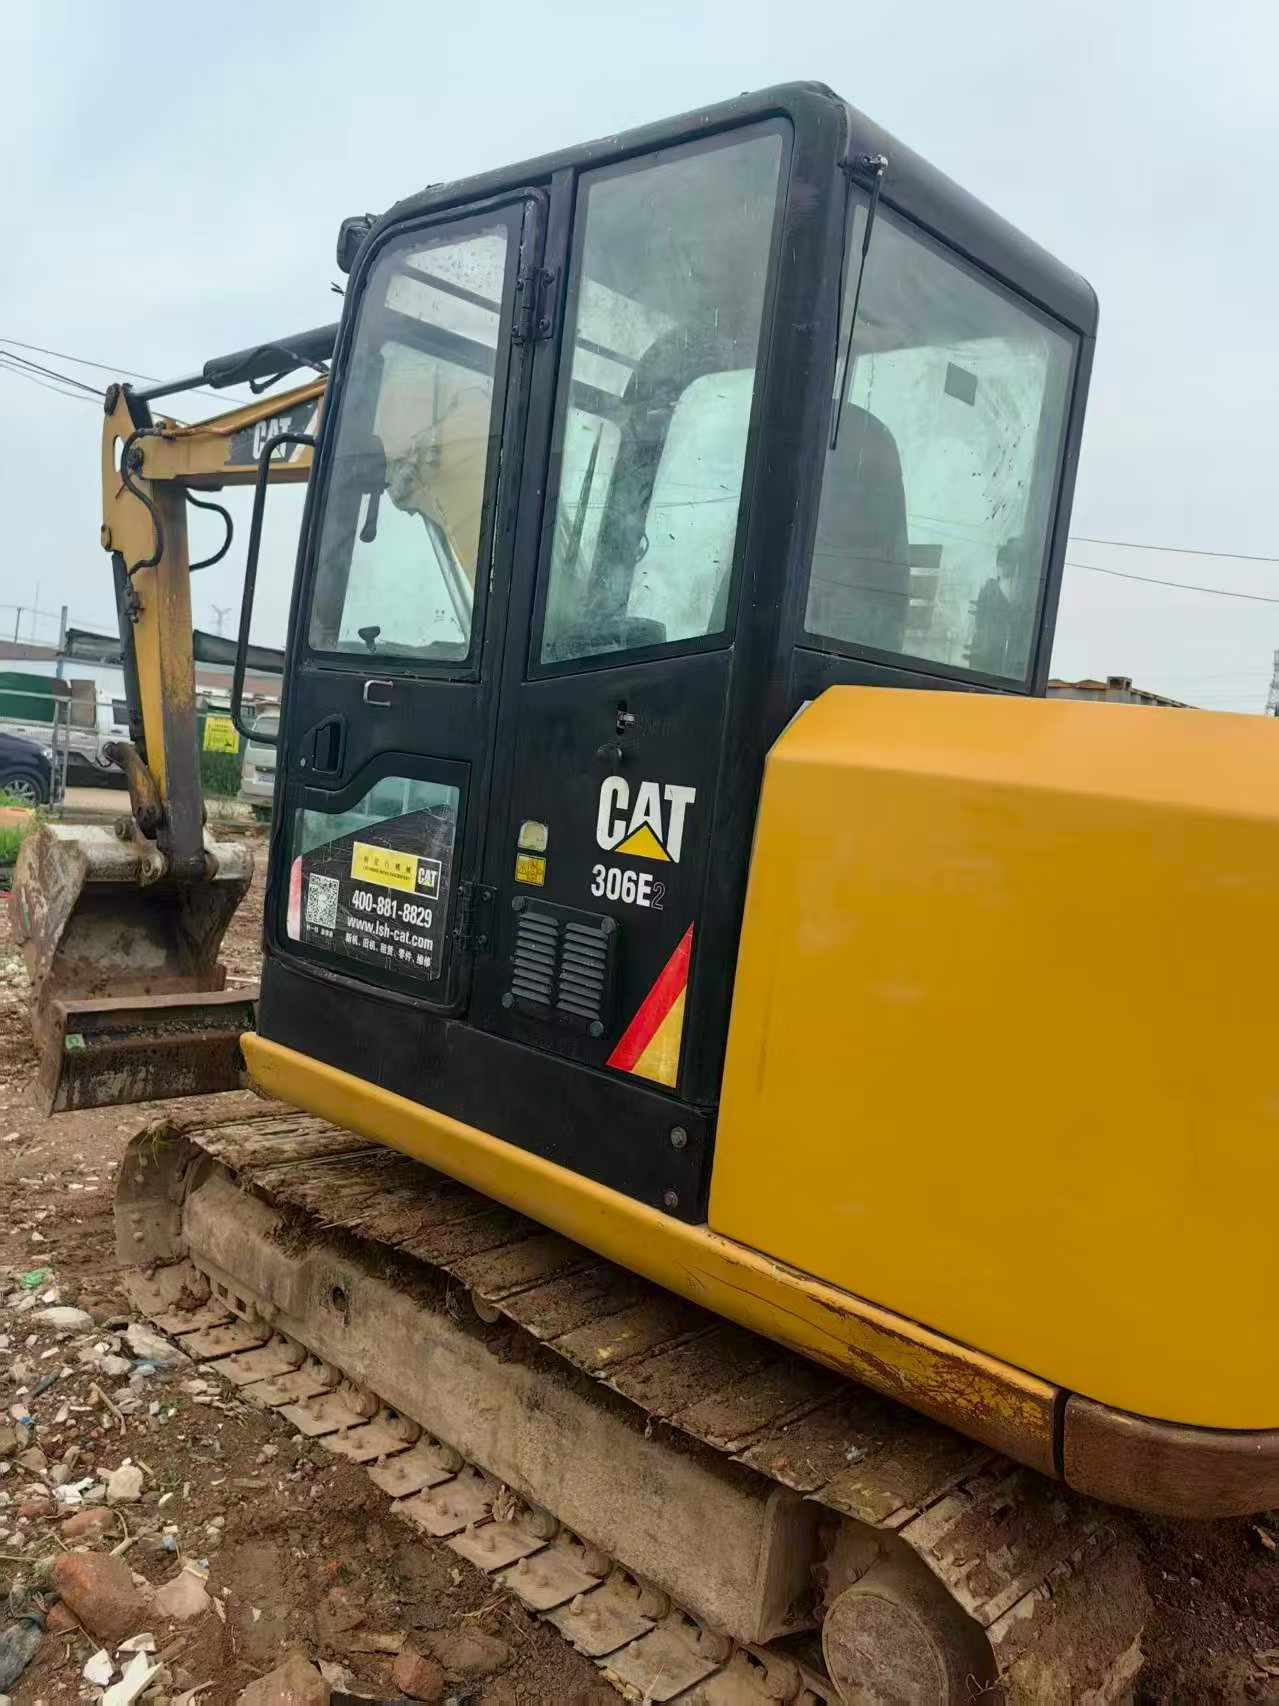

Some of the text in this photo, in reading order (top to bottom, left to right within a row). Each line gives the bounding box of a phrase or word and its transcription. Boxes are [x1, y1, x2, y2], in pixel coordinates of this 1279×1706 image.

[253, 417, 292, 460] CAT
[596, 775, 697, 864] CAT
[418, 867, 437, 887] CAT
[590, 863, 666, 911] 306E2
[352, 890, 432, 928] 400-881-8829
[347, 915, 433, 950] www.lsh-cat.com
